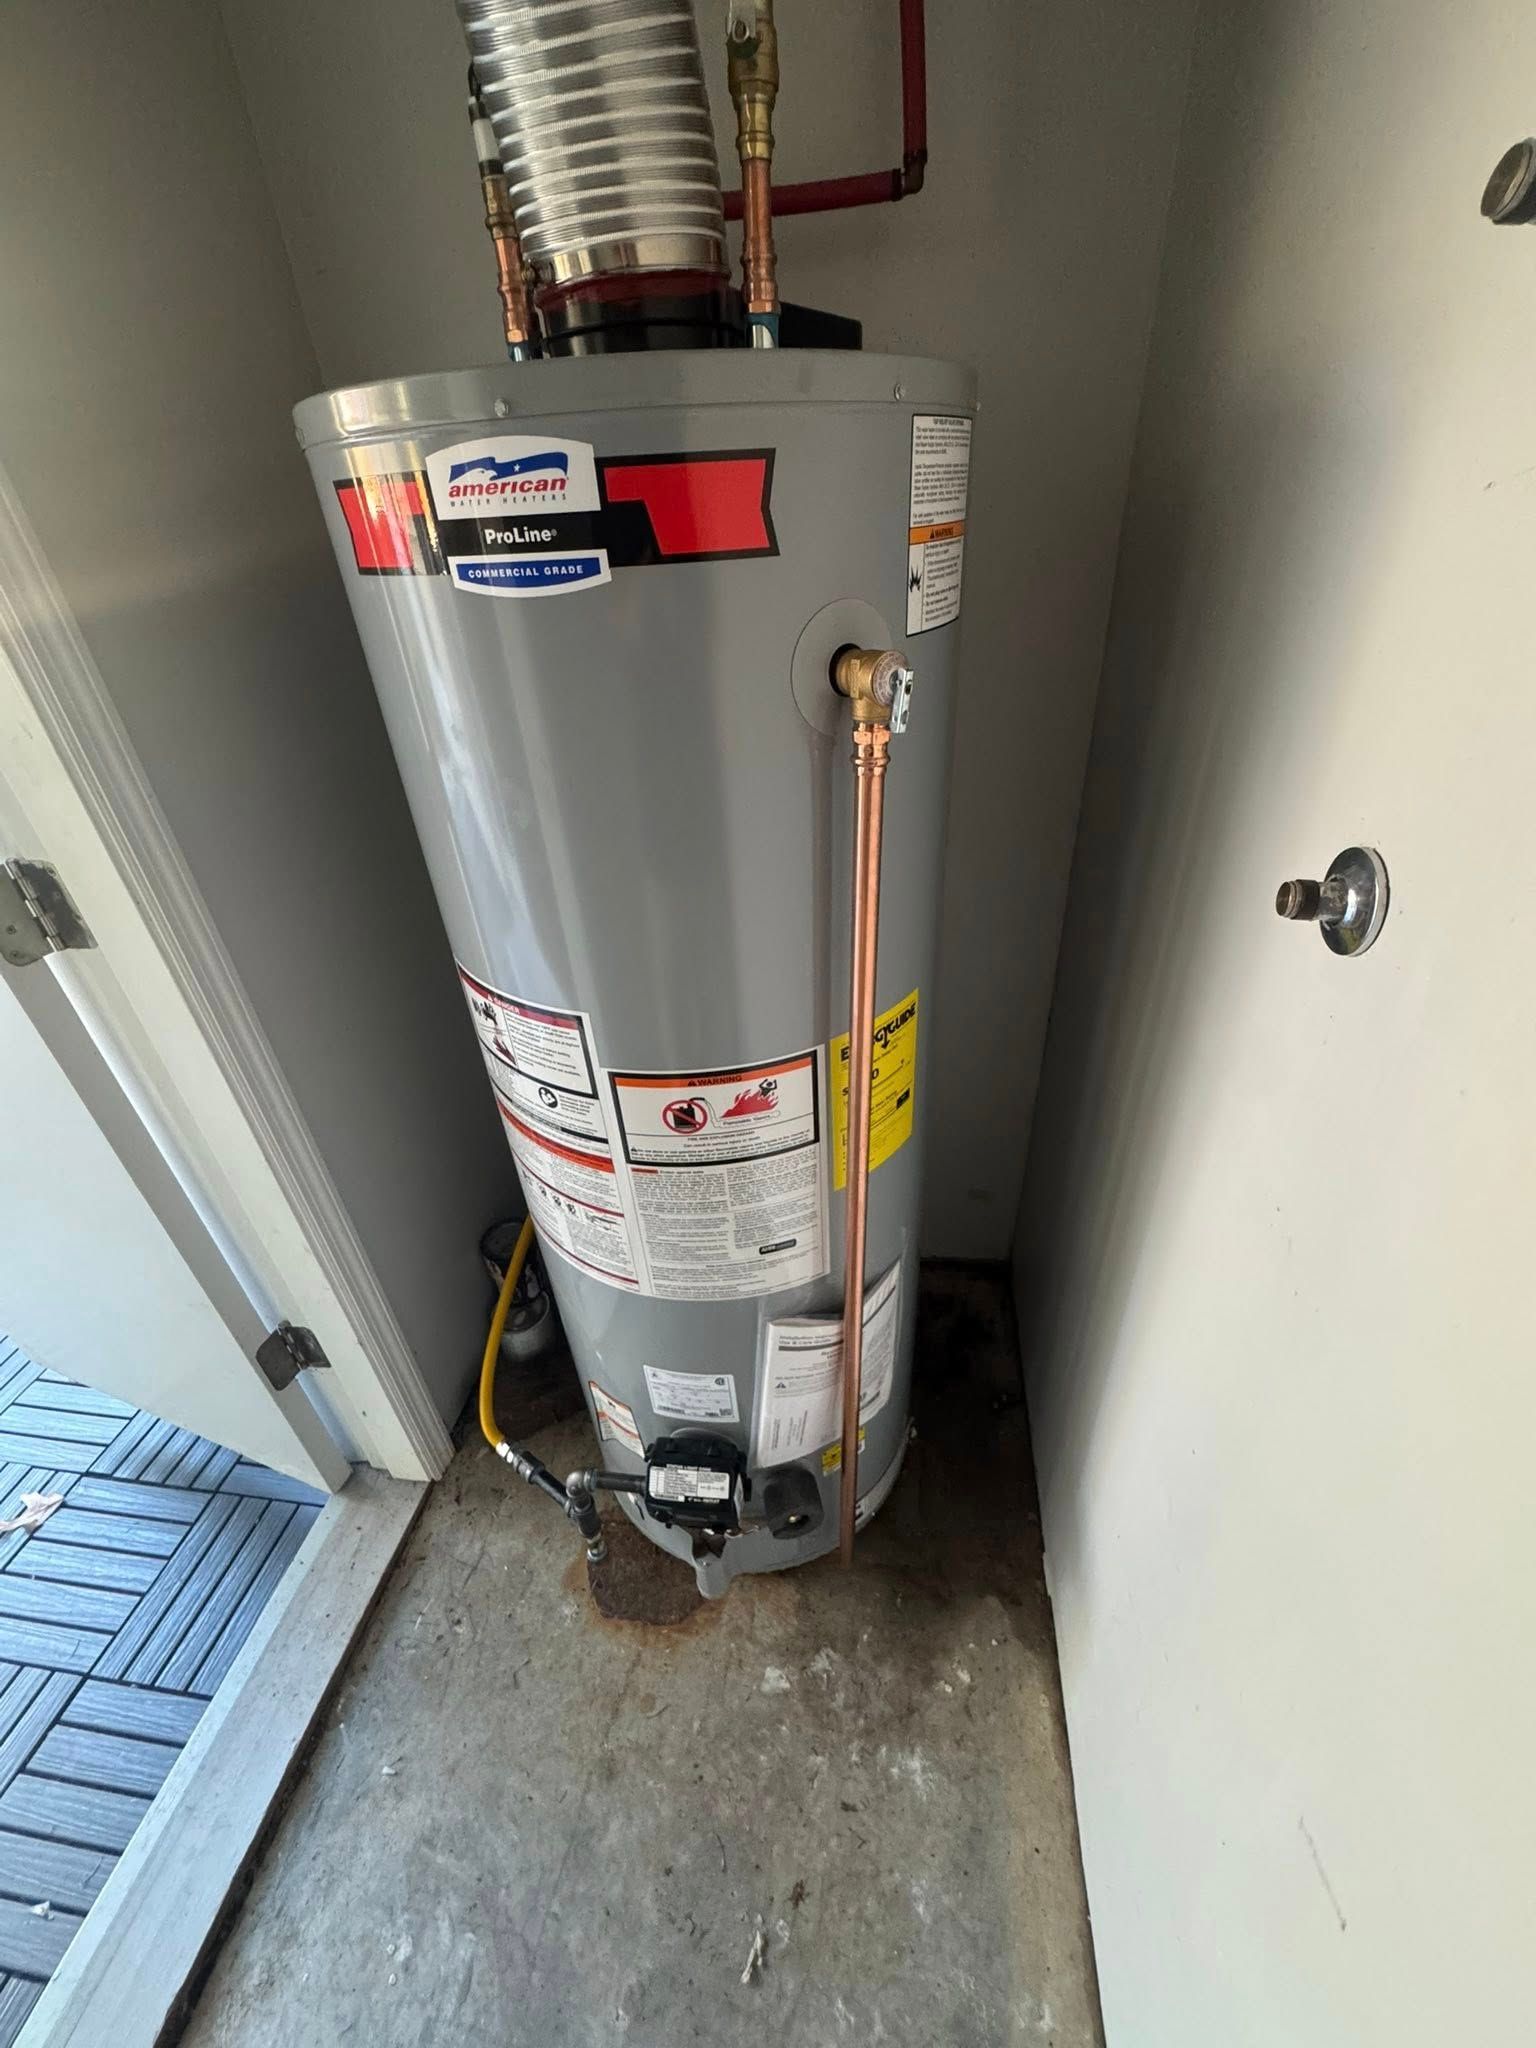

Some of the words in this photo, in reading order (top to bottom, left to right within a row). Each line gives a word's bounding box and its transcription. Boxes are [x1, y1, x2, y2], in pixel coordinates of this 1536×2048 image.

[448, 478, 567, 498] american
[450, 498, 490, 507] WATER
[502, 493, 567, 504] HEATERS
[468, 567, 539, 579] COMMERCIAL
[544, 565, 583, 575] GRADE
[698, 1075, 742, 1086] WARNING
